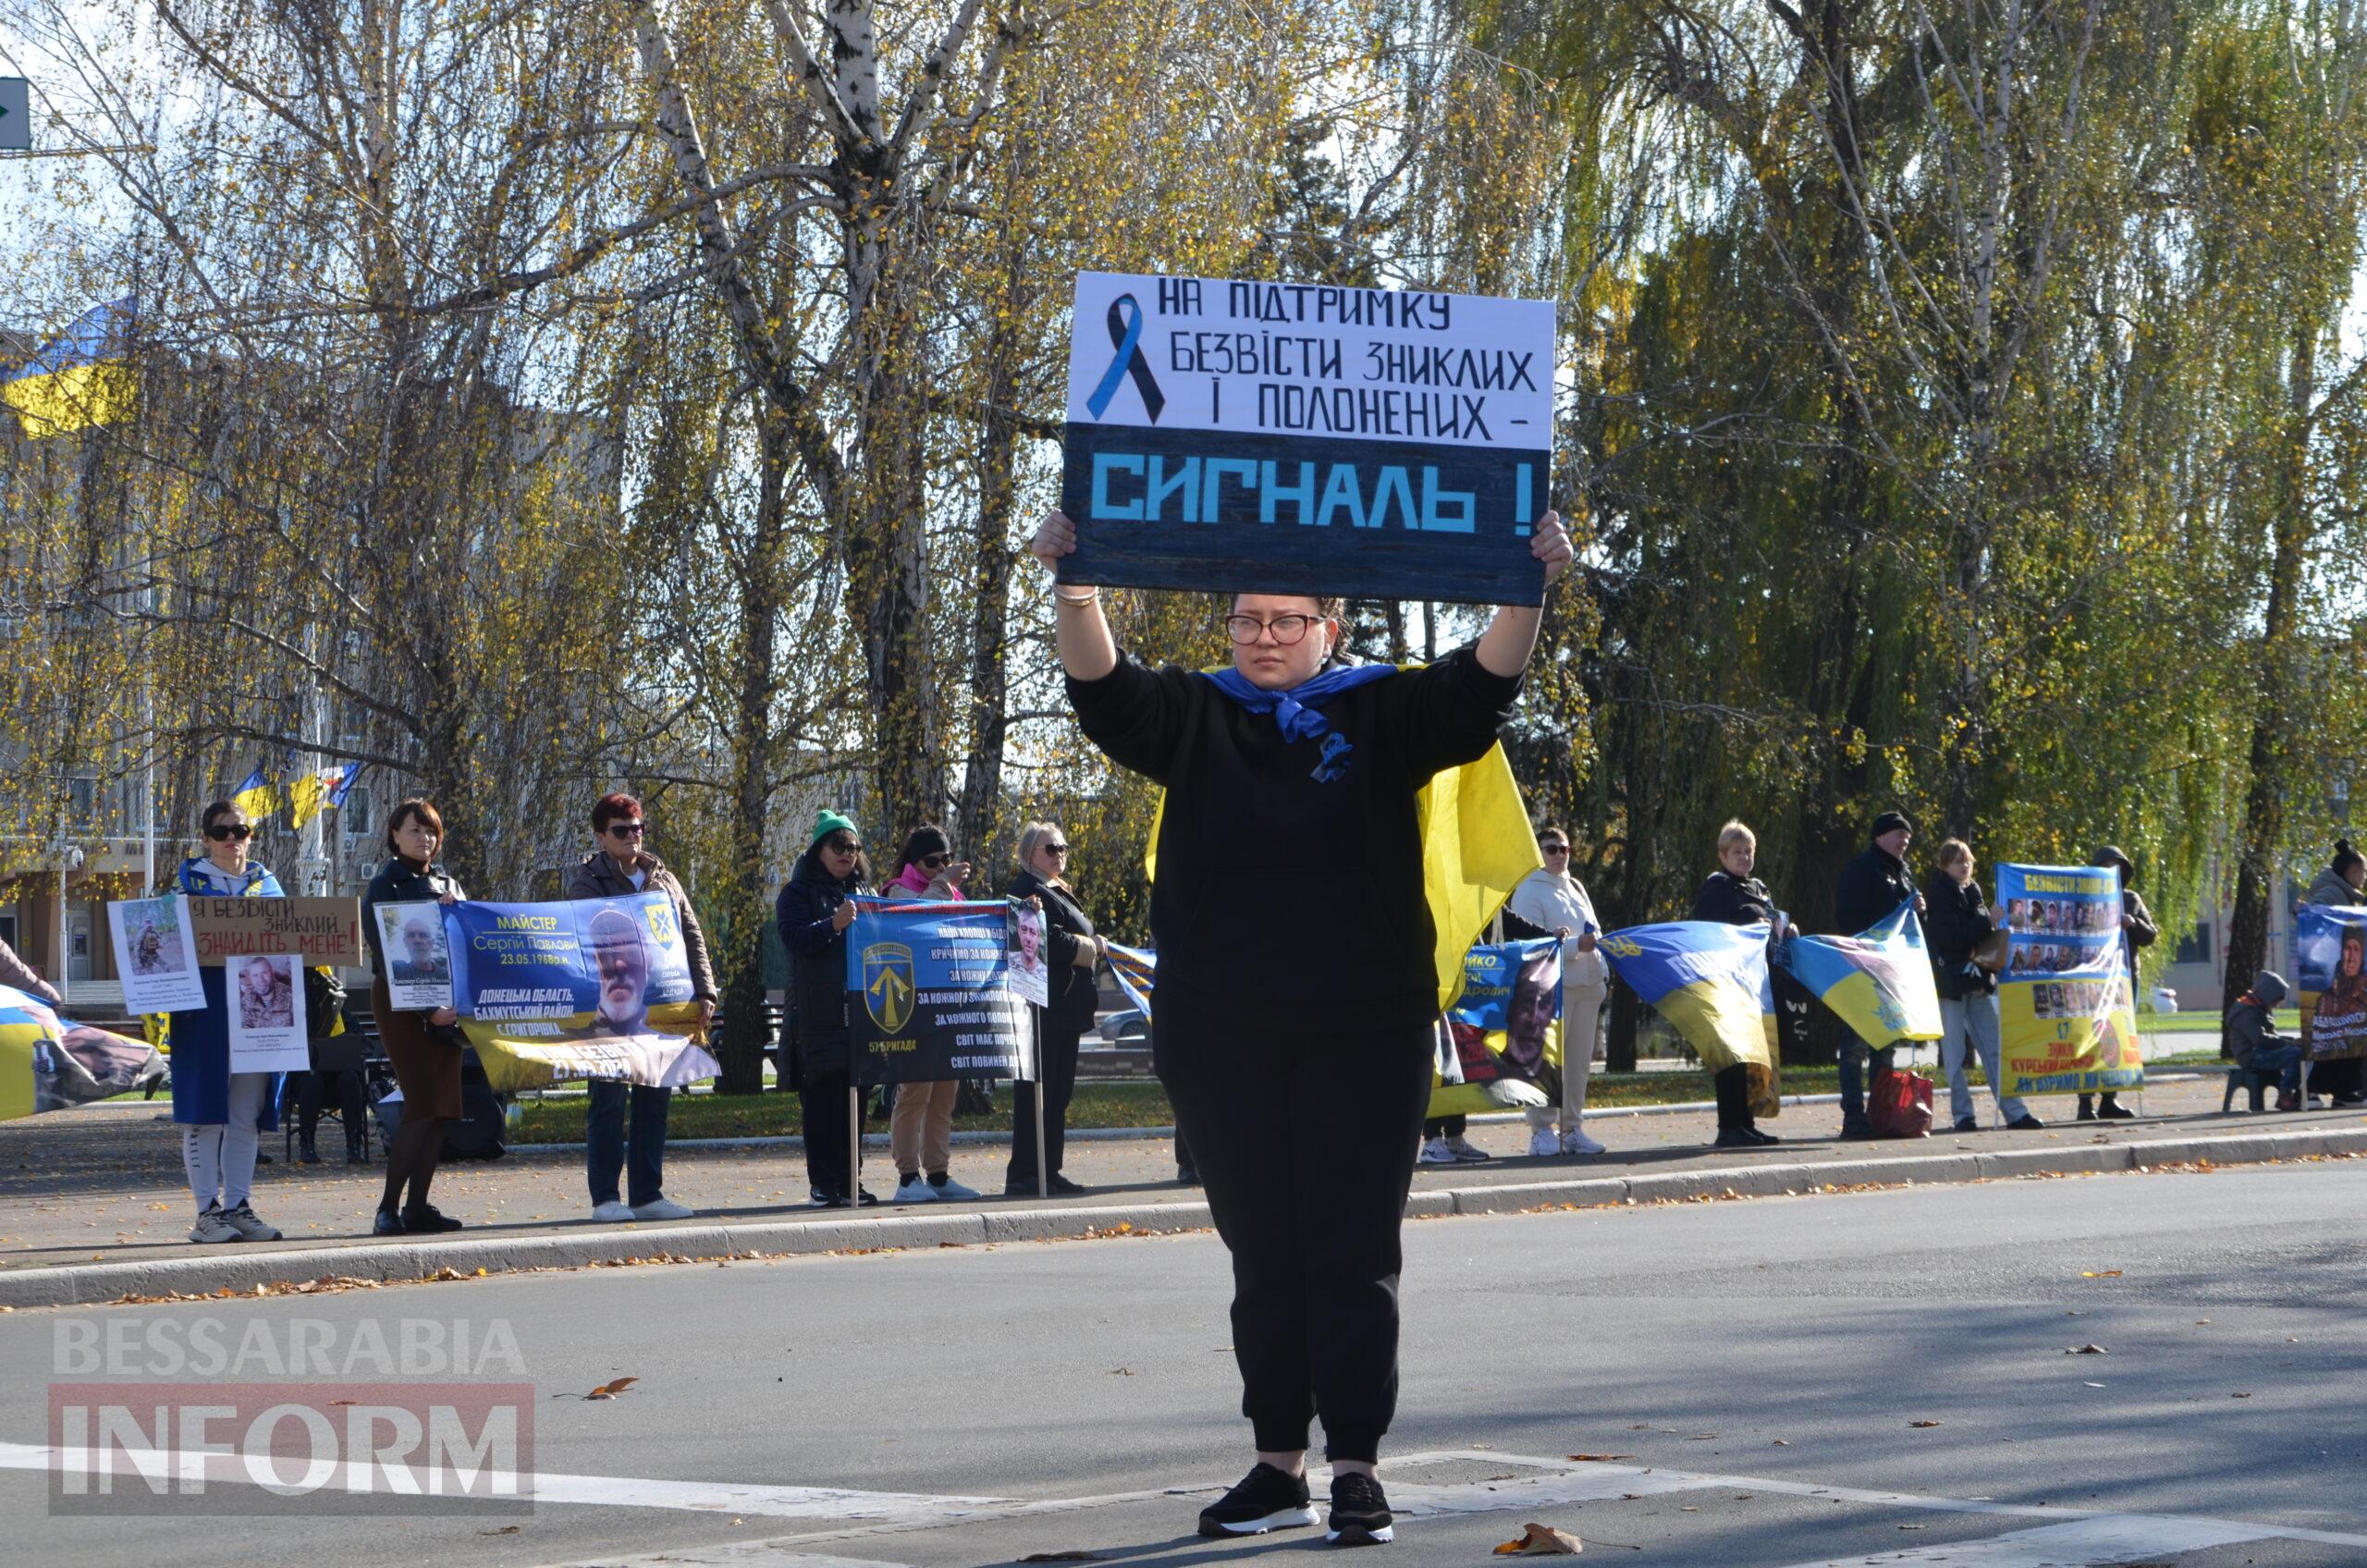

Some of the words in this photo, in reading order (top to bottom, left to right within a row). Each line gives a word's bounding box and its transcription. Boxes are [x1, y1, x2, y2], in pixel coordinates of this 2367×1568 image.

[1159, 278, 1202, 316] НА
[1230, 282, 1450, 331] ПІДТРИМКУ
[1364, 342, 1537, 392] ЗНИКЛИХ
[1258, 383, 1493, 440] ПОЛОНЕНИХ
[1091, 452, 1476, 534] СИГНАЛЬ
[193, 900, 205, 918] Я
[215, 899, 294, 919] БЕЗВІСТИ
[497, 913, 558, 930] МАЙСТЕР
[473, 936, 524, 951] Сергій
[478, 989, 531, 1004] ДОНЕЦЬКА
[917, 992, 930, 1005] ЗА
[473, 1004, 543, 1022] БАХМУТСЬКИЙ
[936, 1013, 948, 1026] ЗА
[948, 1012, 986, 1024] КОЖНОГО
[956, 1034, 975, 1047] СВІТ
[975, 1034, 994, 1046] МАЄ
[950, 1056, 970, 1069] СВІТ
[972, 1055, 1008, 1068] ПОВИНЕН
